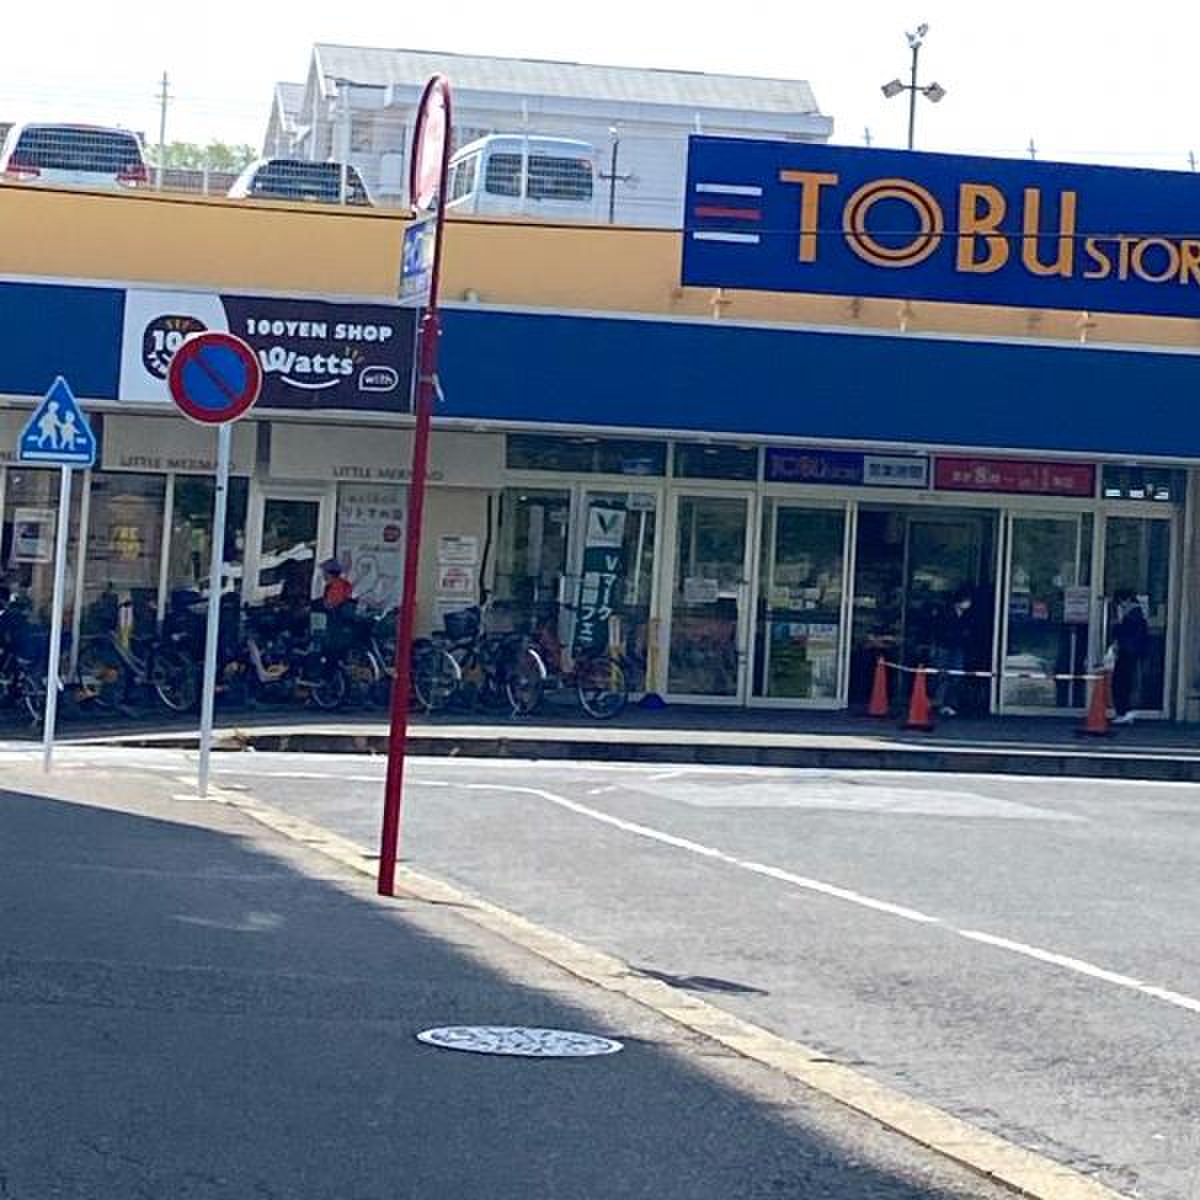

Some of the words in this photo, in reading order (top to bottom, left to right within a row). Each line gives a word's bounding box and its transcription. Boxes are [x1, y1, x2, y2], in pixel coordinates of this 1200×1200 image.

[779, 170, 1077, 279] TOBU
[152, 329, 190, 352] 10
[246, 318, 327, 339] 100YEN
[335, 322, 393, 342] SHOP
[260, 346, 353, 376] Watts
[333, 465, 371, 478] LITTLE
